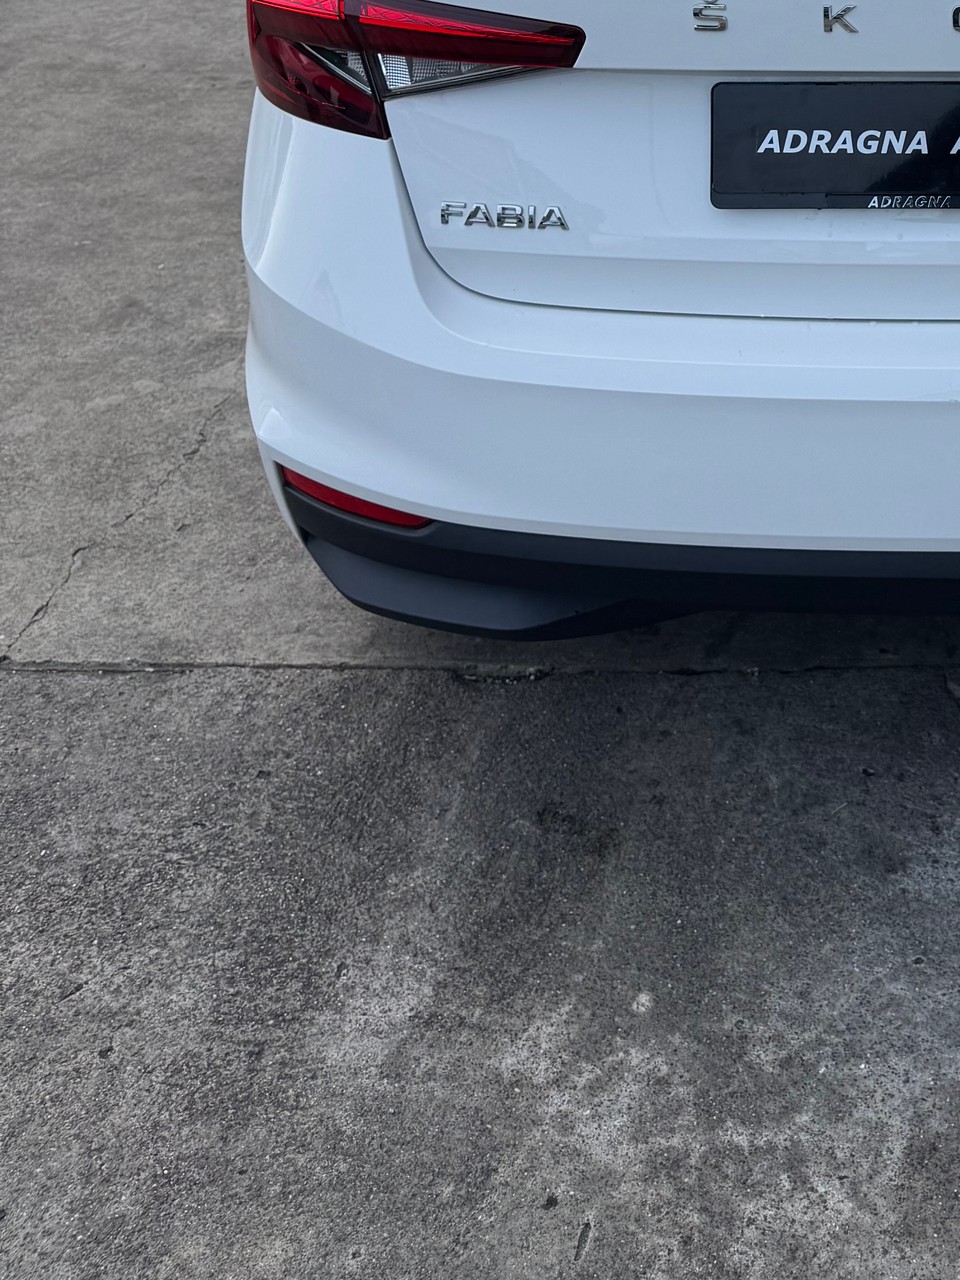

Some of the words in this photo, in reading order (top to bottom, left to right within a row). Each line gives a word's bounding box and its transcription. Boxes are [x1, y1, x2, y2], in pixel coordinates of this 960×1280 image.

[756, 129, 929, 154] ADRAGNA
[867, 195, 951, 208] ADRAGNA
[440, 201, 569, 231] FABIA
